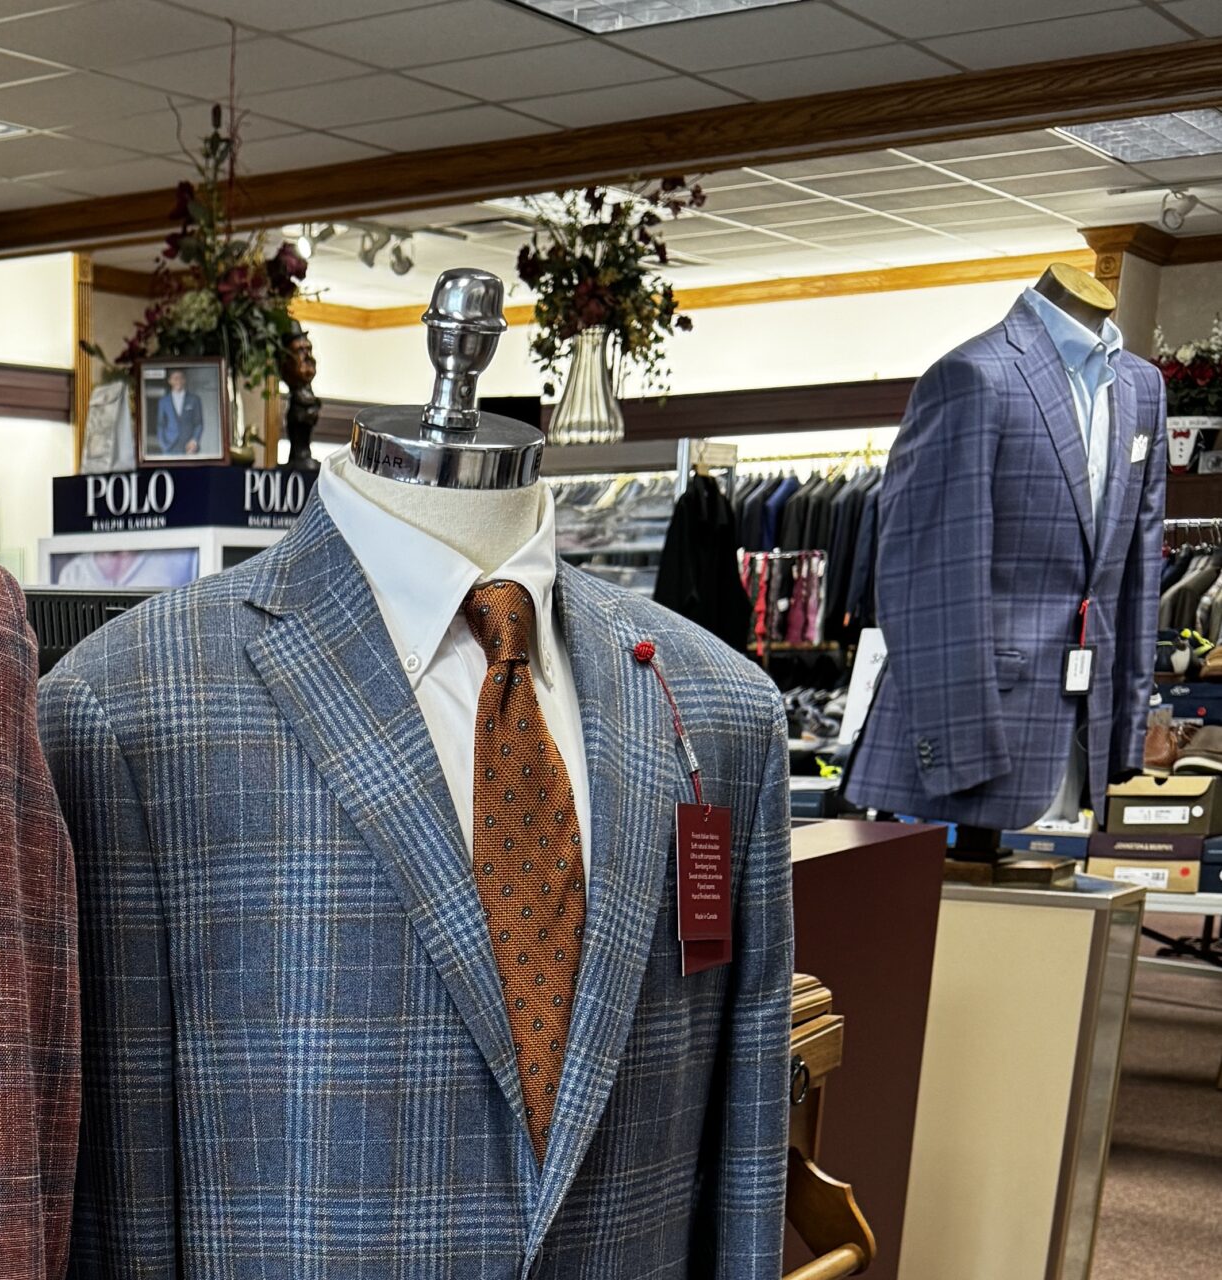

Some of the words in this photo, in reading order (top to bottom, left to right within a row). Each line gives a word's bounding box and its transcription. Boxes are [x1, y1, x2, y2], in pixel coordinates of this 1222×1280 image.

[86, 469, 175, 517] POLO
[243, 470, 305, 513] POLO
[92, 518, 125, 532] RALPH
[128, 514, 167, 529] LAUREN
[248, 514, 271, 527] RALPH
